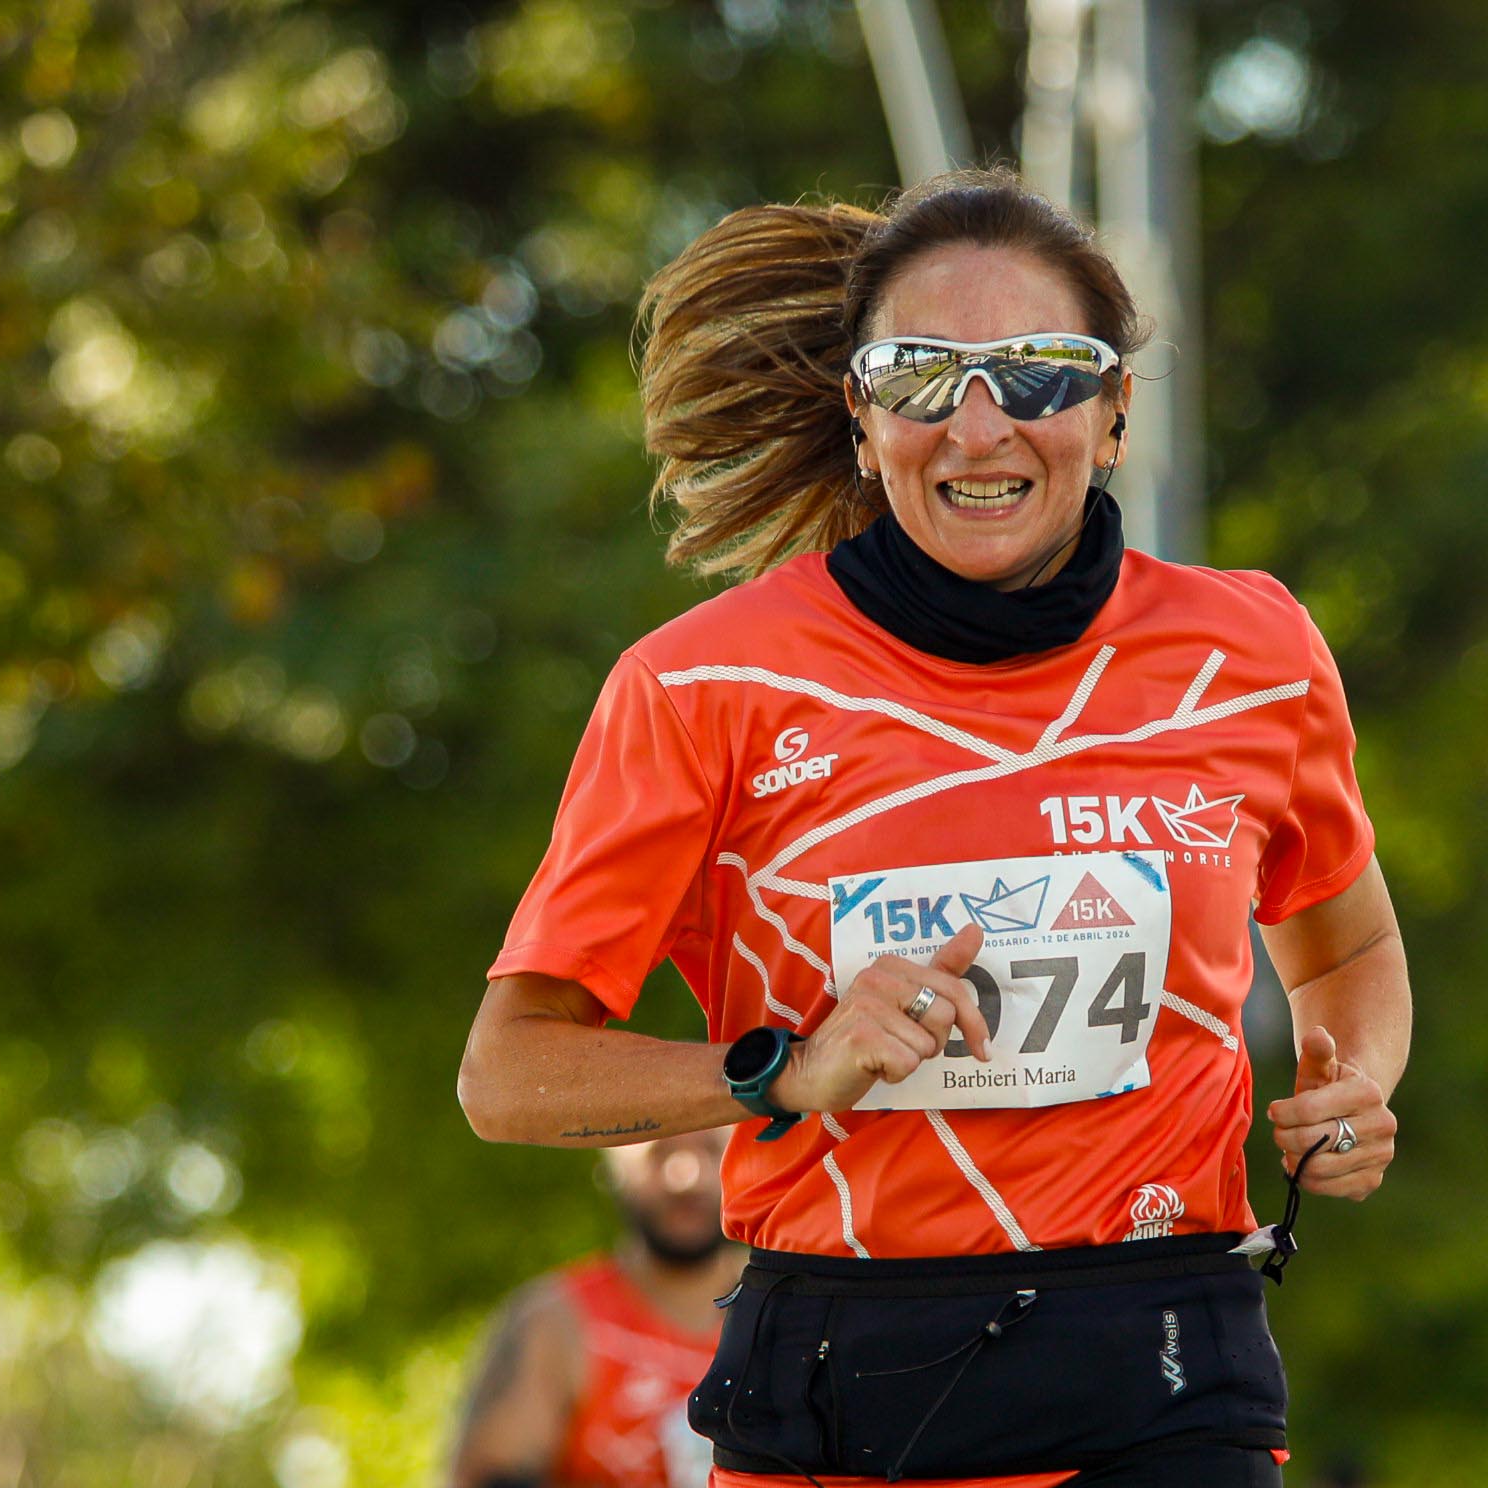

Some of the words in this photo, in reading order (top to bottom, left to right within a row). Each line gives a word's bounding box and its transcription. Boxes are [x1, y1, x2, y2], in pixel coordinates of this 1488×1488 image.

[1040, 795, 1154, 845] 15K
[1165, 850, 1231, 868] NORTE
[864, 894, 958, 944] 15K
[1068, 896, 1115, 922] 15K
[984, 936, 1030, 948] ROSARIO
[1042, 934, 1053, 944] 12
[1057, 933, 1069, 943] DE
[1073, 930, 1103, 942] ABRIL
[1106, 929, 1131, 939] 2026
[943, 1068, 1017, 1089] Barbieri
[1024, 1065, 1076, 1086] Maria
